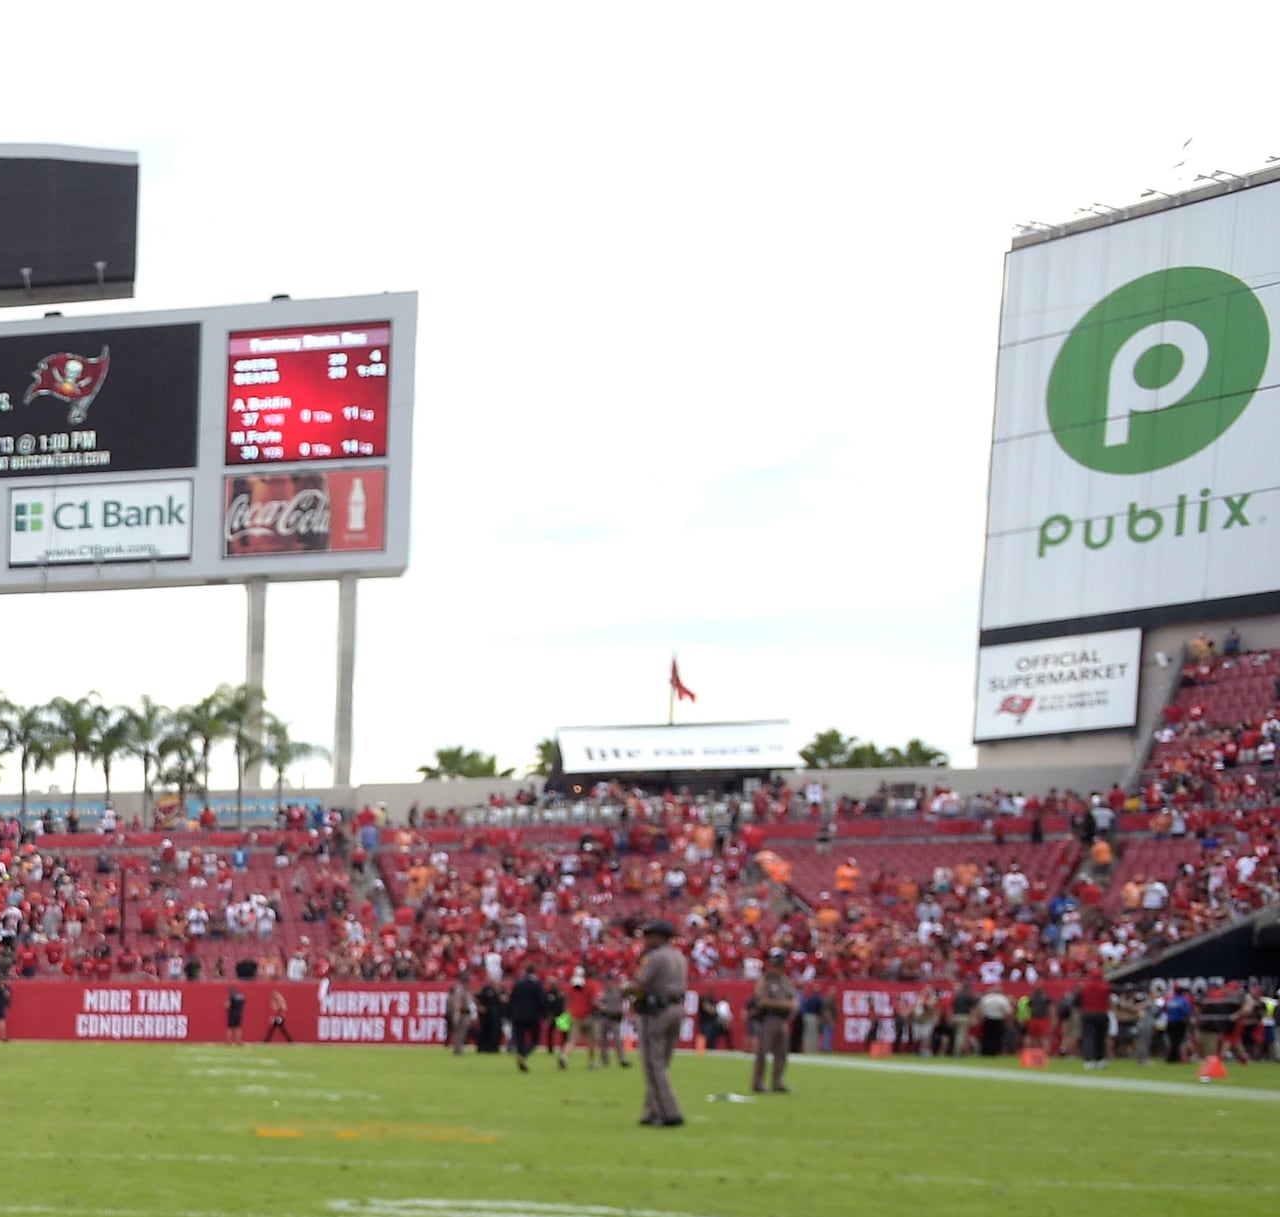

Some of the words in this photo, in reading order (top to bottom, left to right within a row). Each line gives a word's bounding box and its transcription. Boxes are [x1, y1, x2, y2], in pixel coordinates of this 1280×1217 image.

[70, 430, 96, 450] PM
[10, 451, 110, 470] BUCCANEERS.COM
[53, 500, 94, 530] C1
[102, 495, 186, 528] Bank
[1037, 487, 1251, 558] Publix
[1015, 649, 1102, 673] OFFICIAL
[989, 662, 1128, 692] SUPERMARKET
[83, 989, 131, 1013] MORE
[139, 989, 181, 1013] THAN
[320, 990, 410, 1016] MURPHY'S
[76, 1014, 188, 1040] CONQUERORS
[318, 1016, 385, 1041] DOWNS
[391, 1016, 404, 1040] 4
[408, 1016, 448, 1041] LIFE
